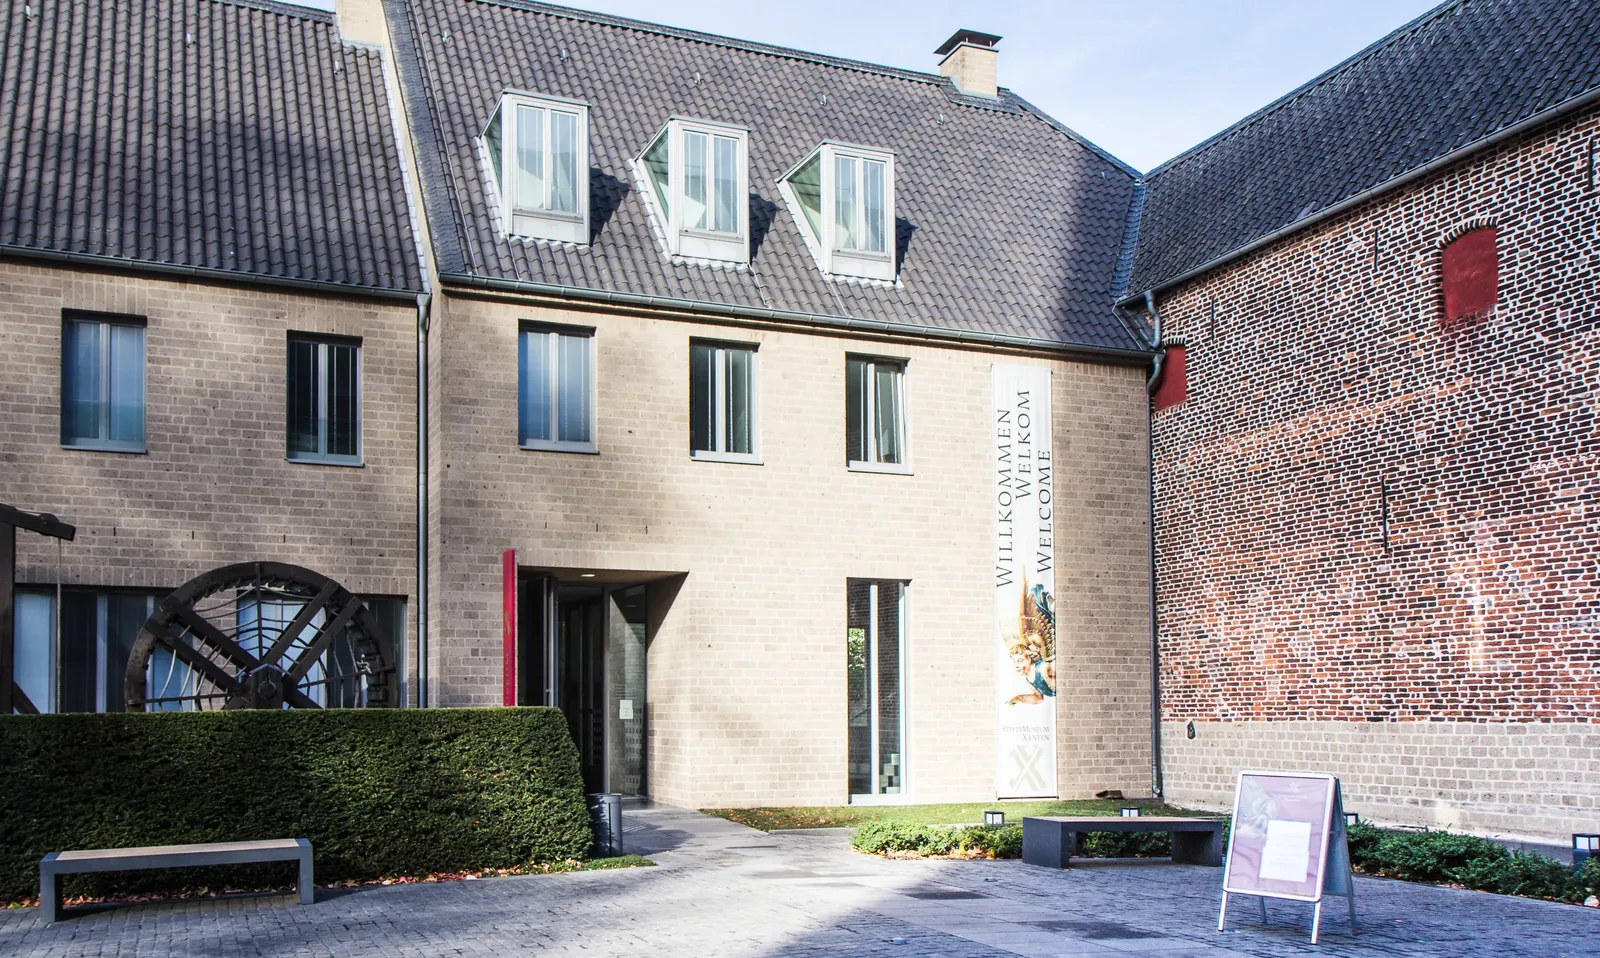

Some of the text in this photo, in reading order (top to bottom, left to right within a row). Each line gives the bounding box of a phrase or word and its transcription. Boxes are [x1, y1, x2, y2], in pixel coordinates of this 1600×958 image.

[996, 409, 1013, 588] WILLKOMMEN
[1015, 390, 1032, 500] WELKOM
[1036, 450, 1052, 574] WELCOME
